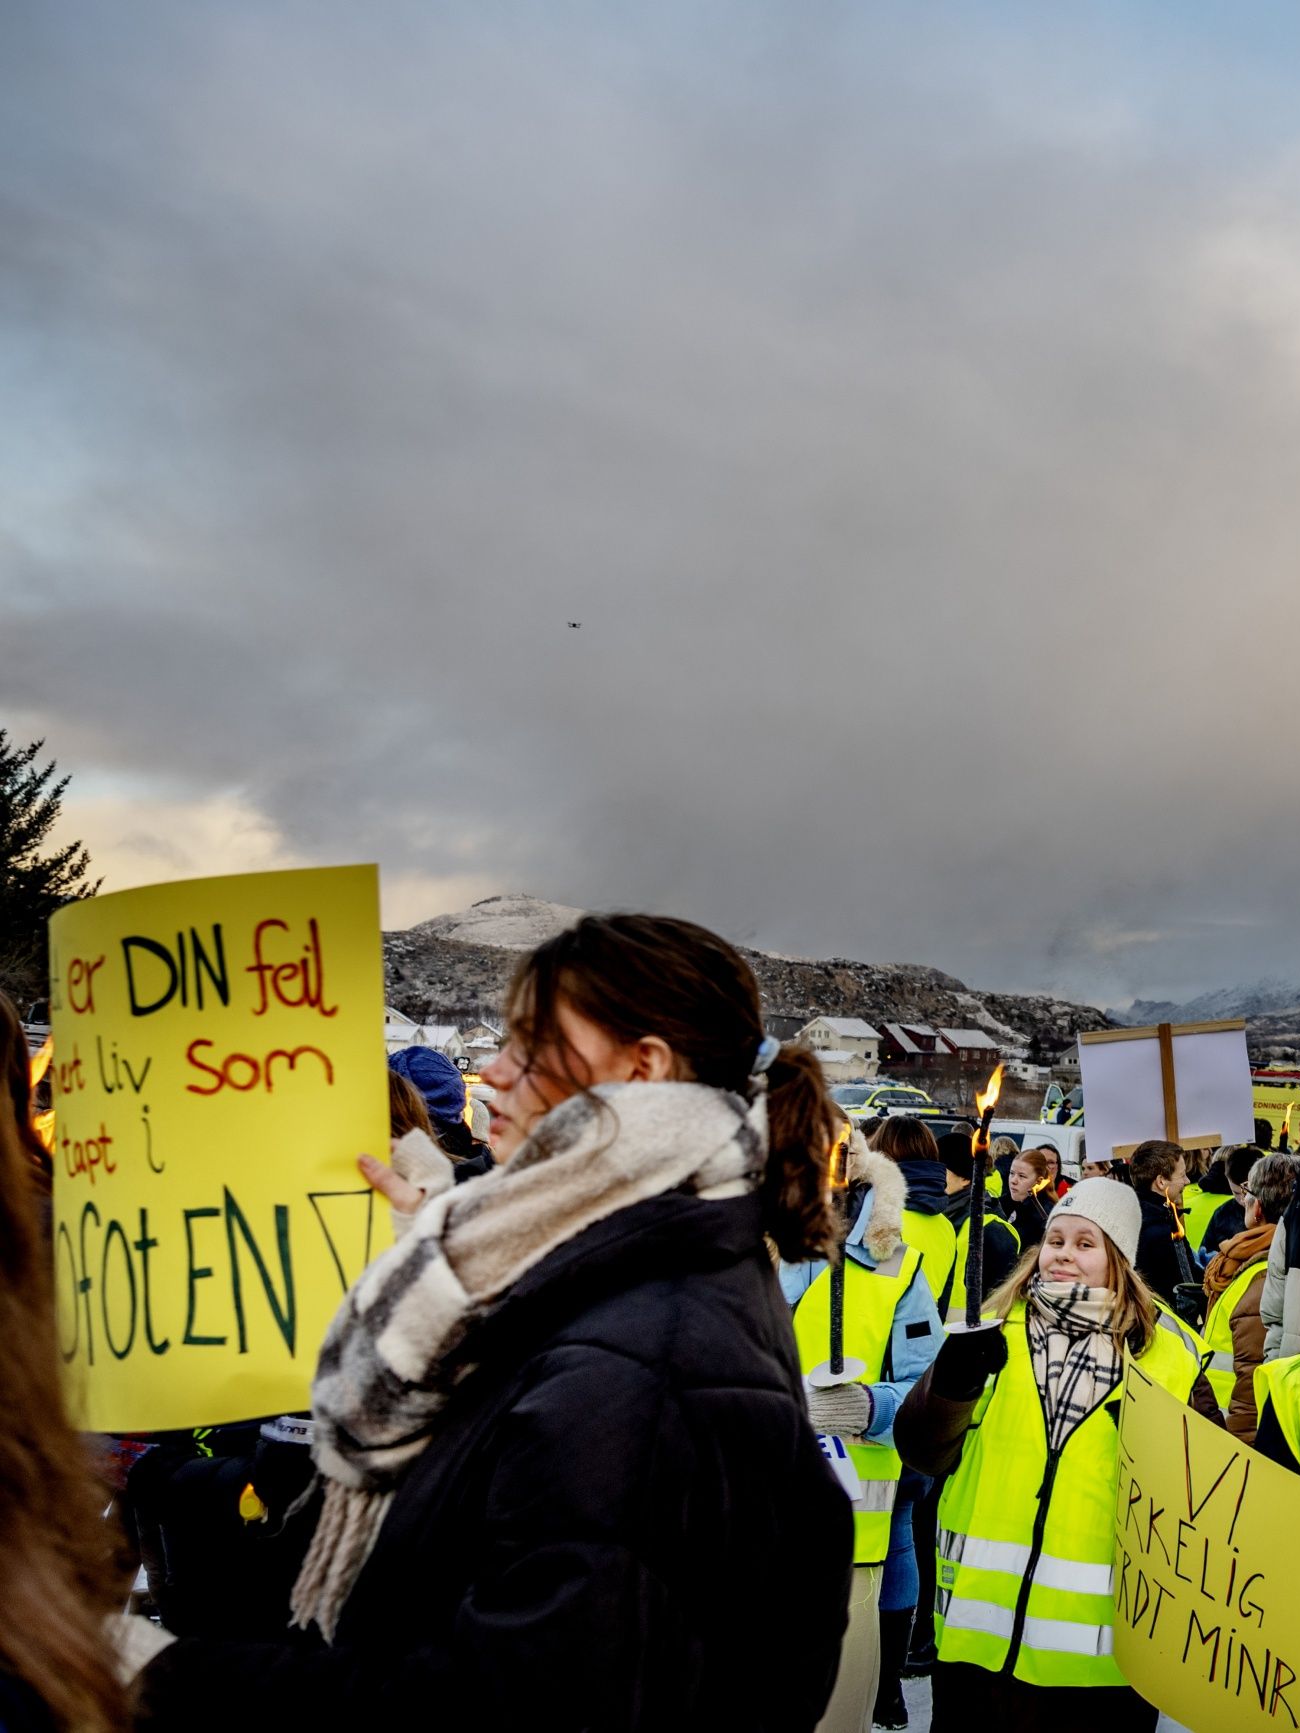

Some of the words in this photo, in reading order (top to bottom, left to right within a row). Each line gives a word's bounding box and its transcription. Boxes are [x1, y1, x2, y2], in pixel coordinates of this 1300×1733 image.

[68, 954, 105, 1014] er
[121, 922, 229, 1017] DIN
[246, 917, 339, 1018] feil
[96, 1034, 152, 1094] liv
[61, 1122, 117, 1185] tapt
[141, 1104, 165, 1174] i
[1182, 1413, 1250, 1546] VI
